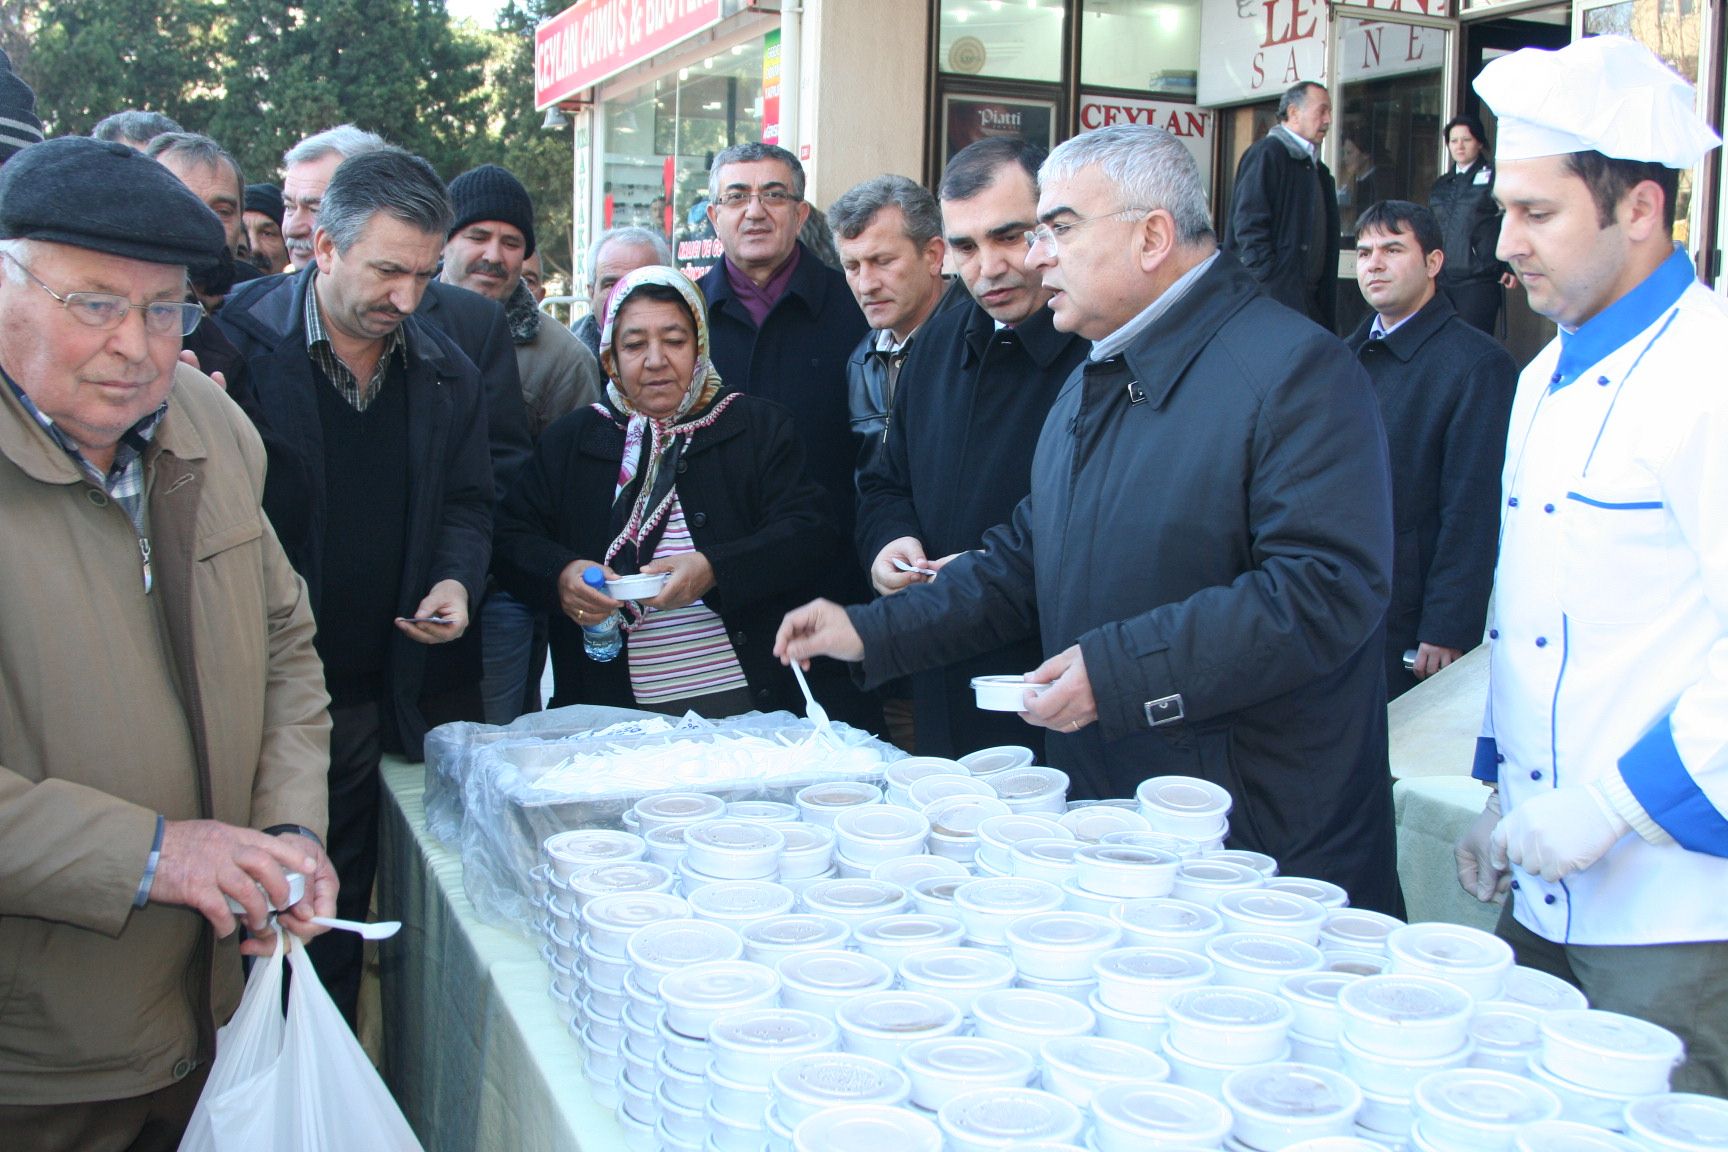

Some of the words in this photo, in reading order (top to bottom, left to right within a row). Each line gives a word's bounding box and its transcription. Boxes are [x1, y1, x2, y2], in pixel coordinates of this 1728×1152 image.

[536, 22, 579, 93] CEYLAN
[978, 108, 1022, 126] Piatti
[1080, 103, 1209, 139] CEYLAN
